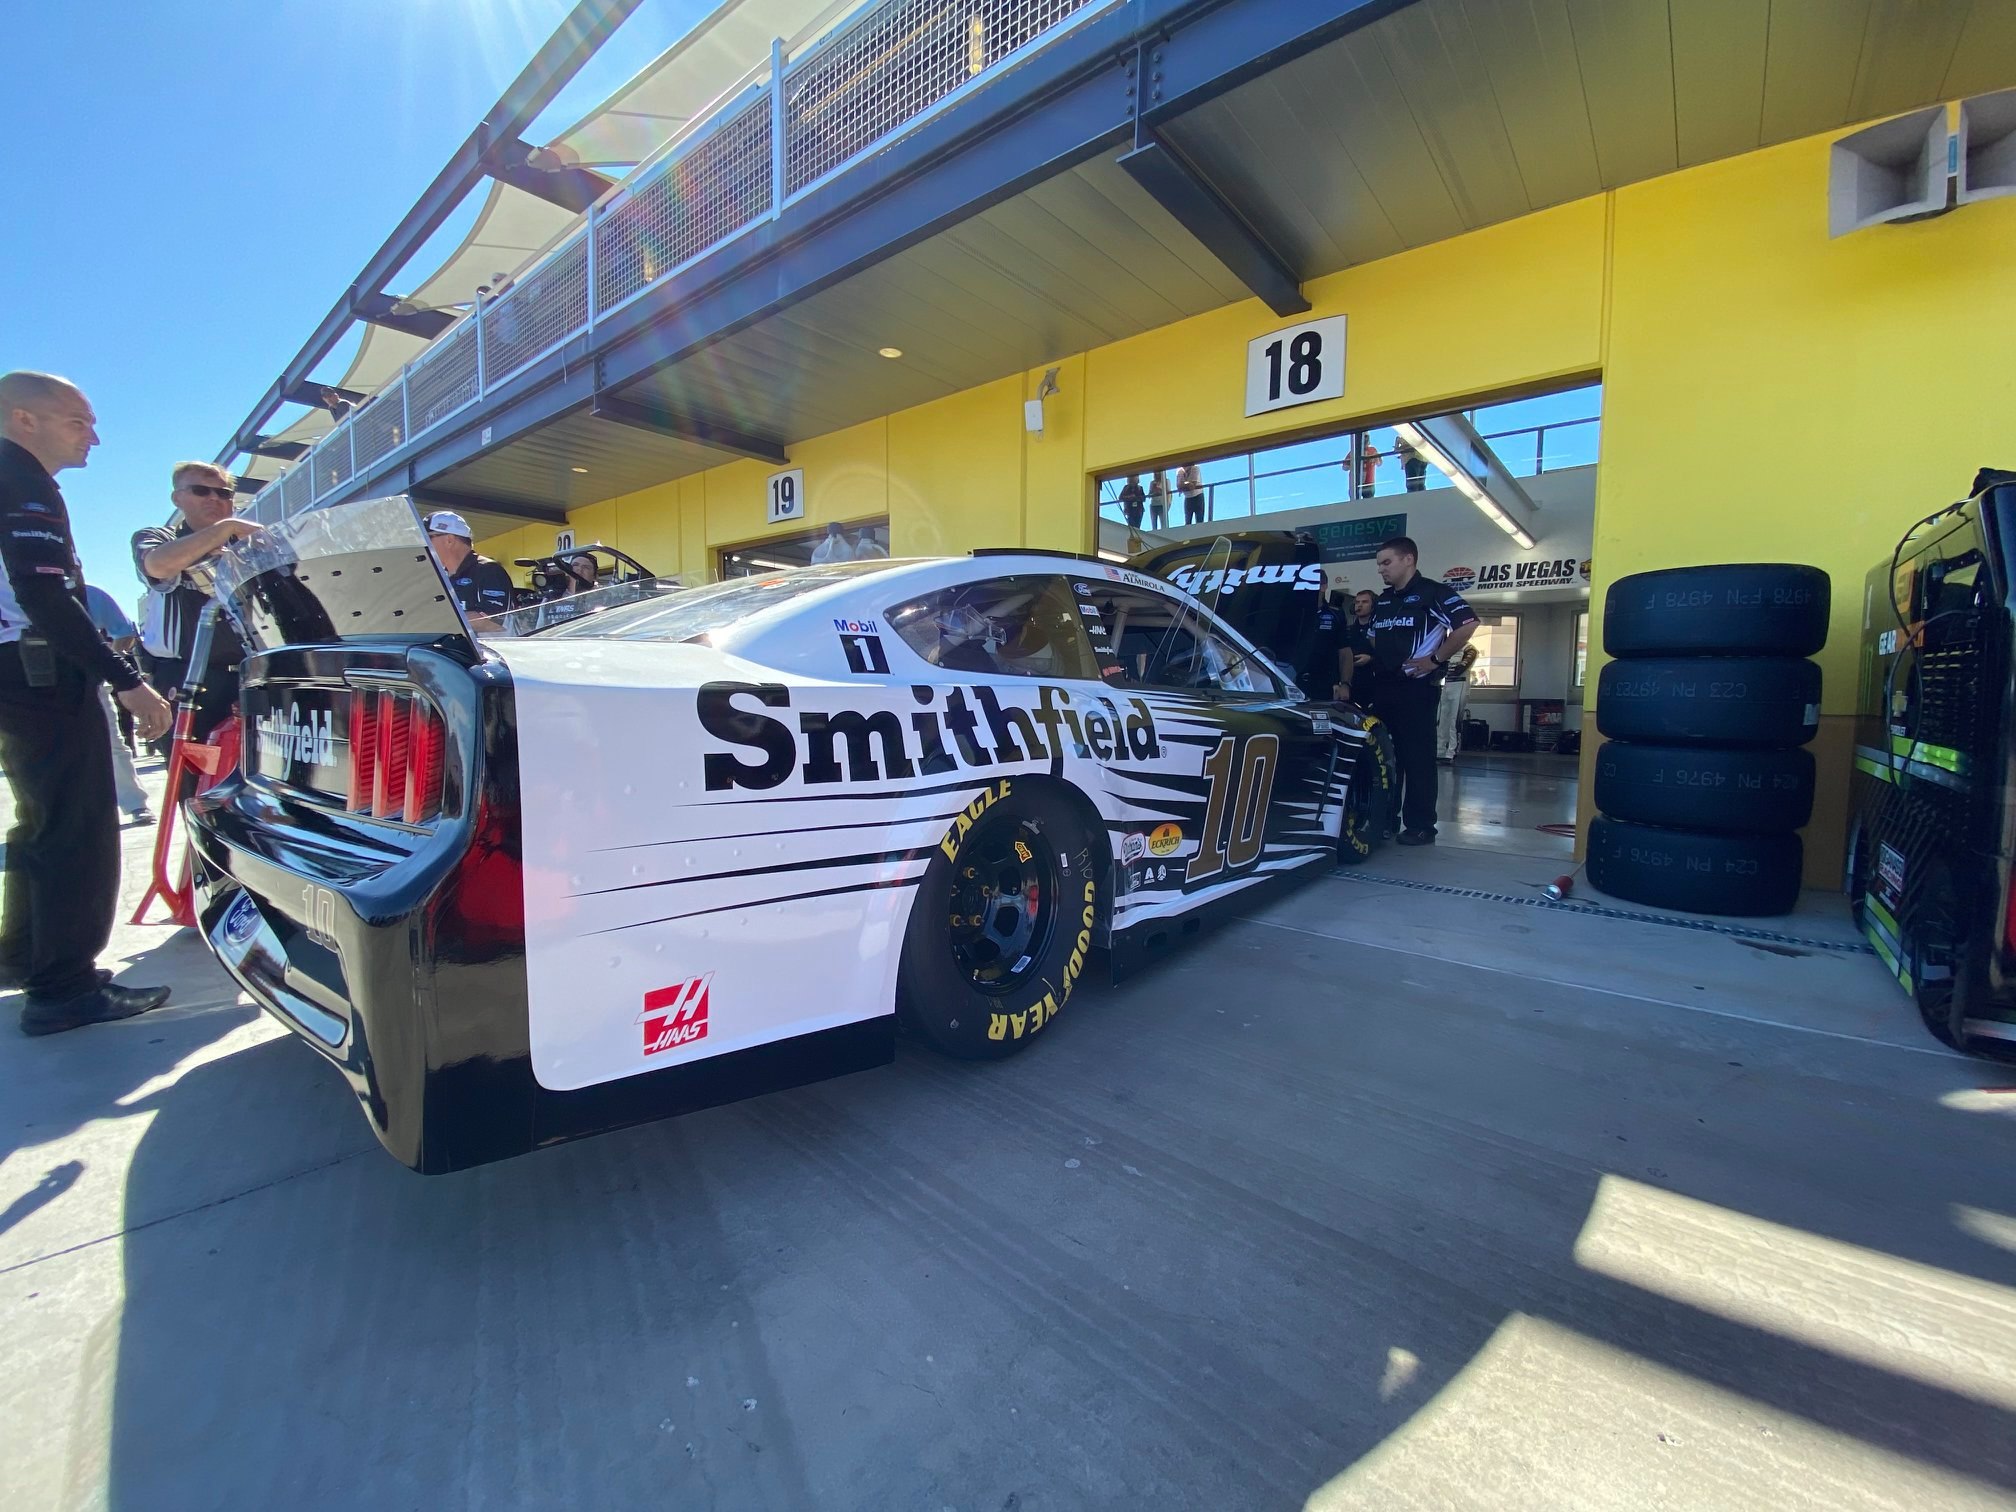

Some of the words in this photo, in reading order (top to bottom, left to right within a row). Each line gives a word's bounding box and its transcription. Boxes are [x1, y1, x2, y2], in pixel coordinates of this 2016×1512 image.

[1265, 330, 1322, 401] 18
[772, 476, 795, 516] 19
[1319, 517, 1398, 545] genesys
[1123, 573, 1165, 592] ALMIROLA
[1477, 582, 1513, 590] MOTOR
[1516, 578, 1572, 588] SPEEDWAY
[1478, 564, 1512, 582] LAS
[1515, 559, 1577, 579] VEGAS
[1666, 591, 1714, 608] 4978
[833, 619, 878, 633] Mobil
[697, 681, 1161, 791] Smithfield
[1676, 769, 1726, 786] 4976
[941, 779, 1012, 864] EAGLE
[1185, 734, 1279, 884] 10
[1151, 836, 1180, 850] ECKRICH
[1686, 856, 1711, 873] PN
[302, 884, 339, 954] 10
[987, 880, 1096, 1041] GOODYEAR
[644, 1019, 708, 1052] HAAS
